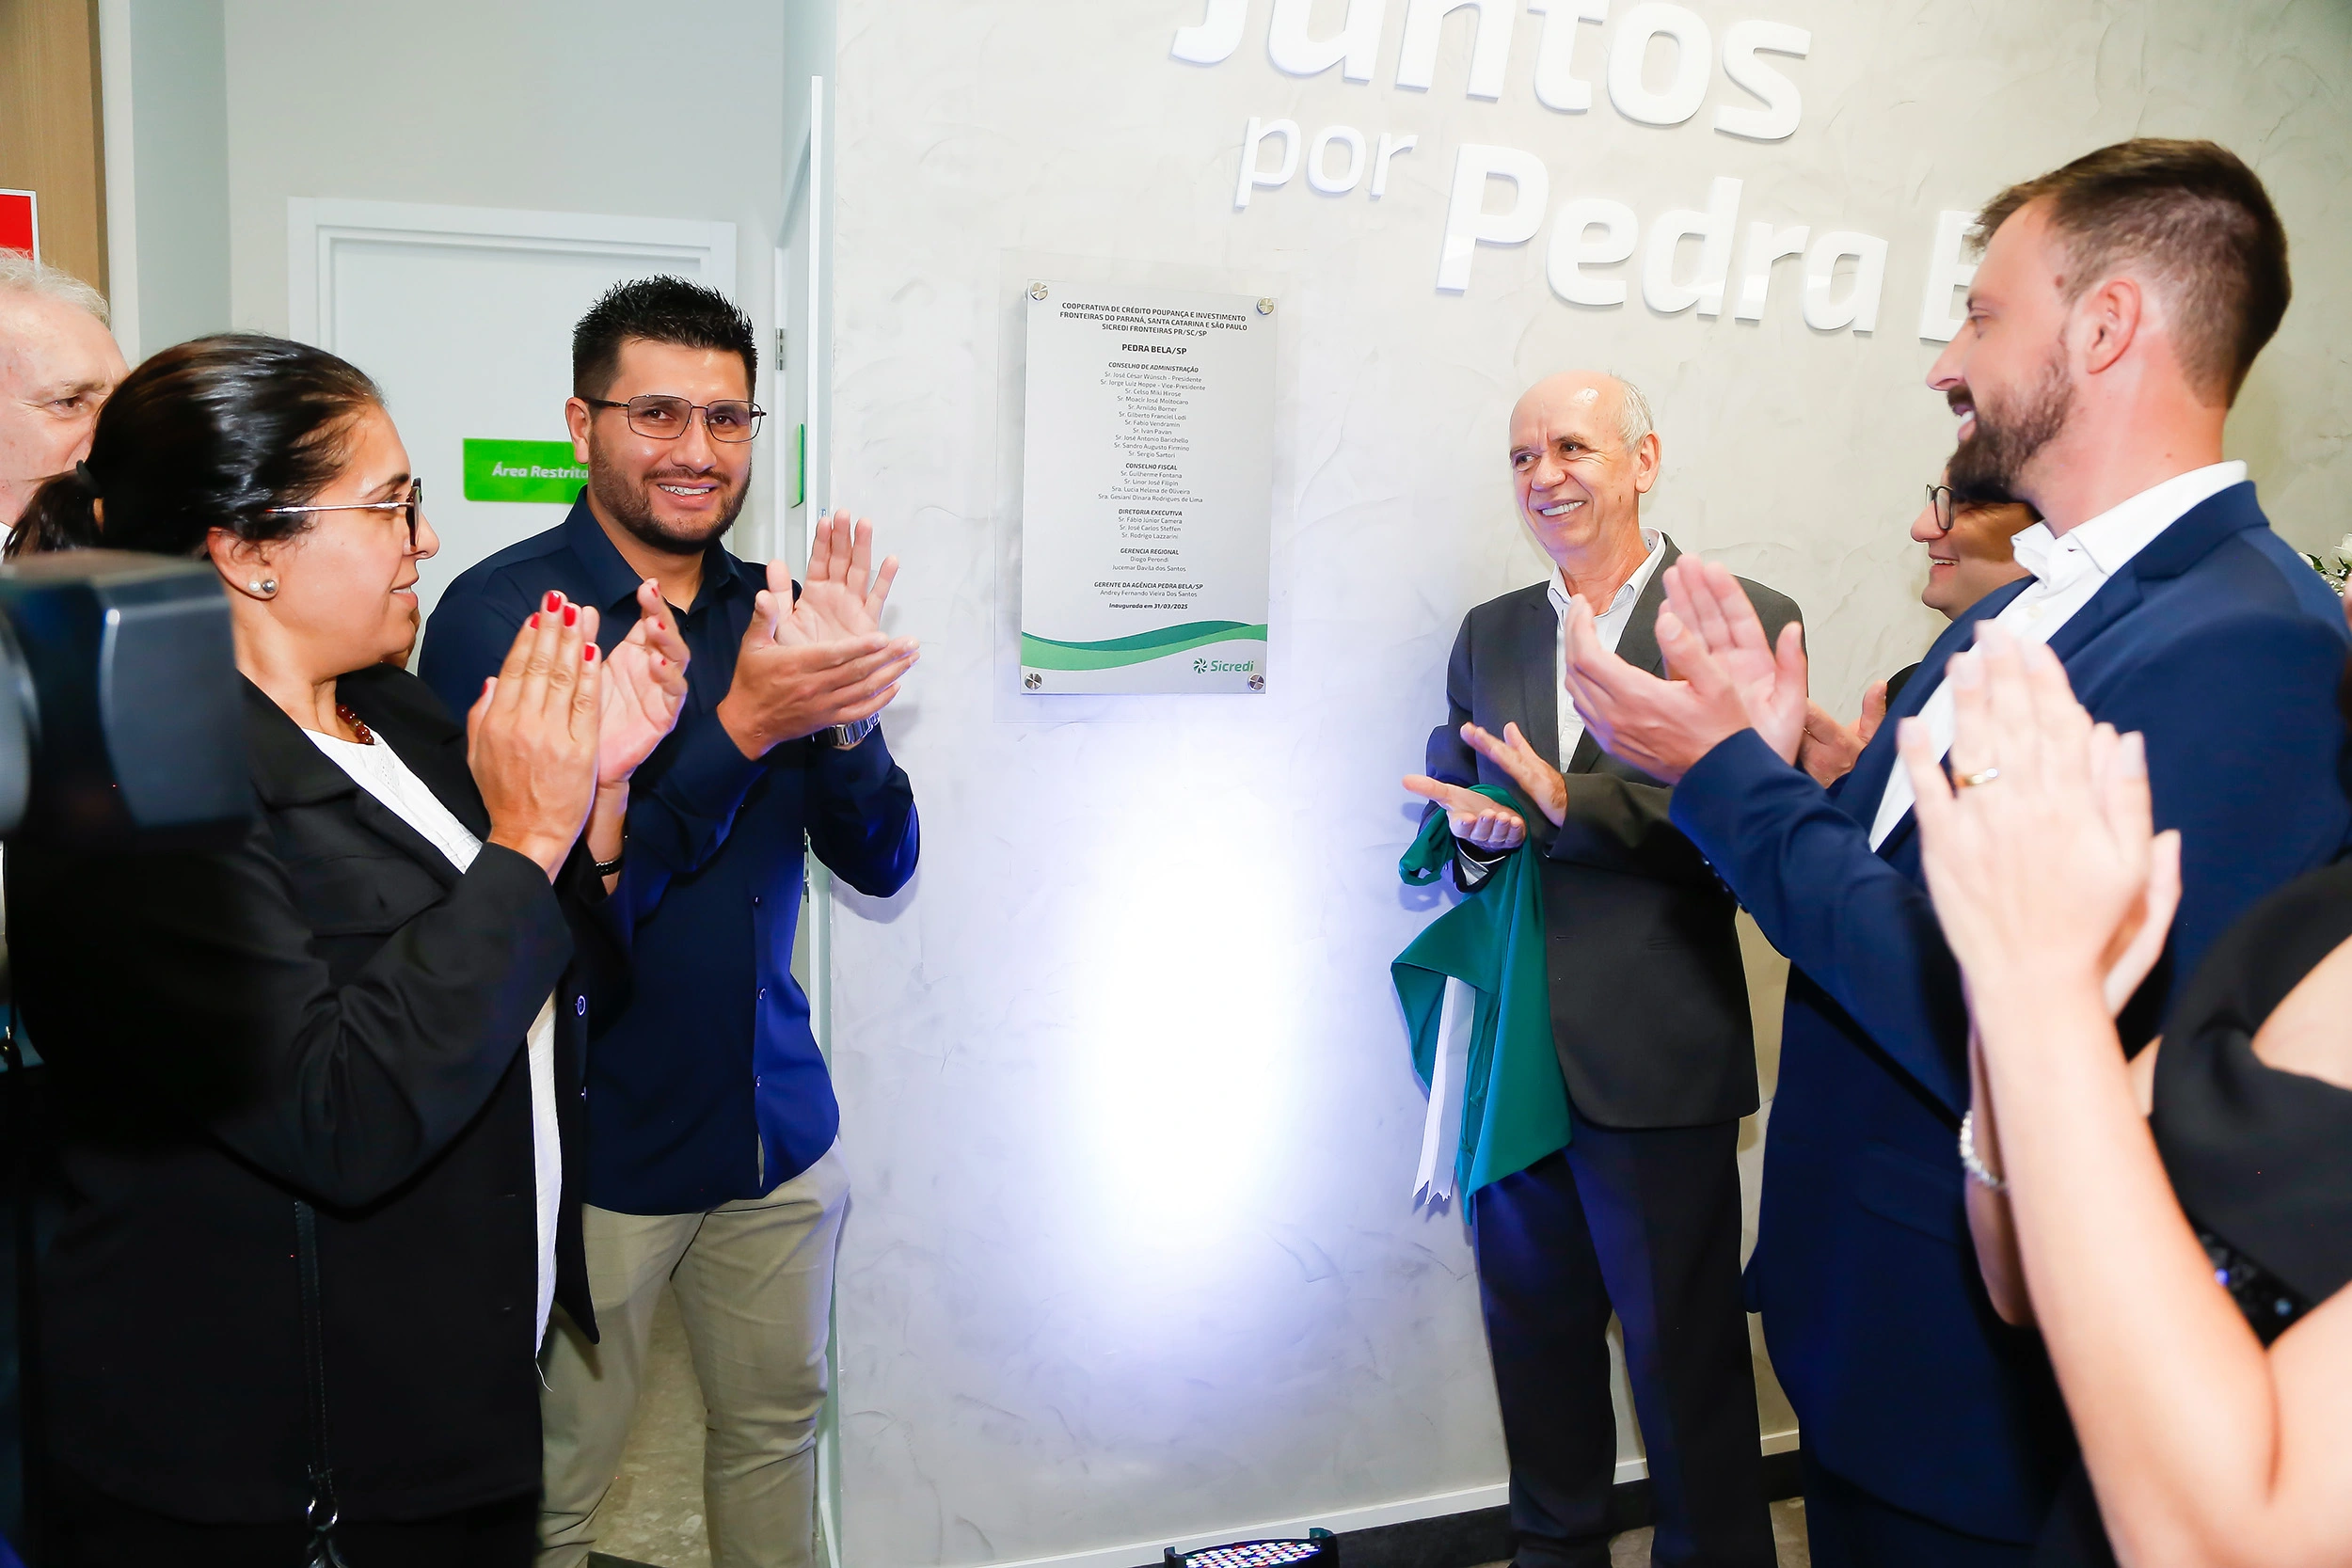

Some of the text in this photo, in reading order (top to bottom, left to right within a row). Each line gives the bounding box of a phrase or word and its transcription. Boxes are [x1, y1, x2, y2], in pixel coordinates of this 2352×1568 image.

[1234, 116, 1419, 211] por
[1436, 142, 1890, 335] Pedra
[1062, 303, 1110, 311] COOPERATIVA
[1121, 306, 1151, 314] CRÉDITO
[1152, 309, 1189, 318] POUPANÇA
[1196, 312, 1246, 322] INVESTIMENTO
[1060, 312, 1104, 321] FRONTEIRAS
[1117, 315, 1146, 324] PARANÁ,
[1211, 321, 1224, 329] SÃO
[1130, 325, 1172, 334] FRONTEIRAS
[1174, 328, 1207, 337] PR/SC/SP
[1152, 346, 1186, 355] BELA/SP
[1150, 365, 1199, 373] ADMINISTRAÇÃO
[492, 461, 527, 477] Área
[1210, 660, 1254, 672] Sicredi
